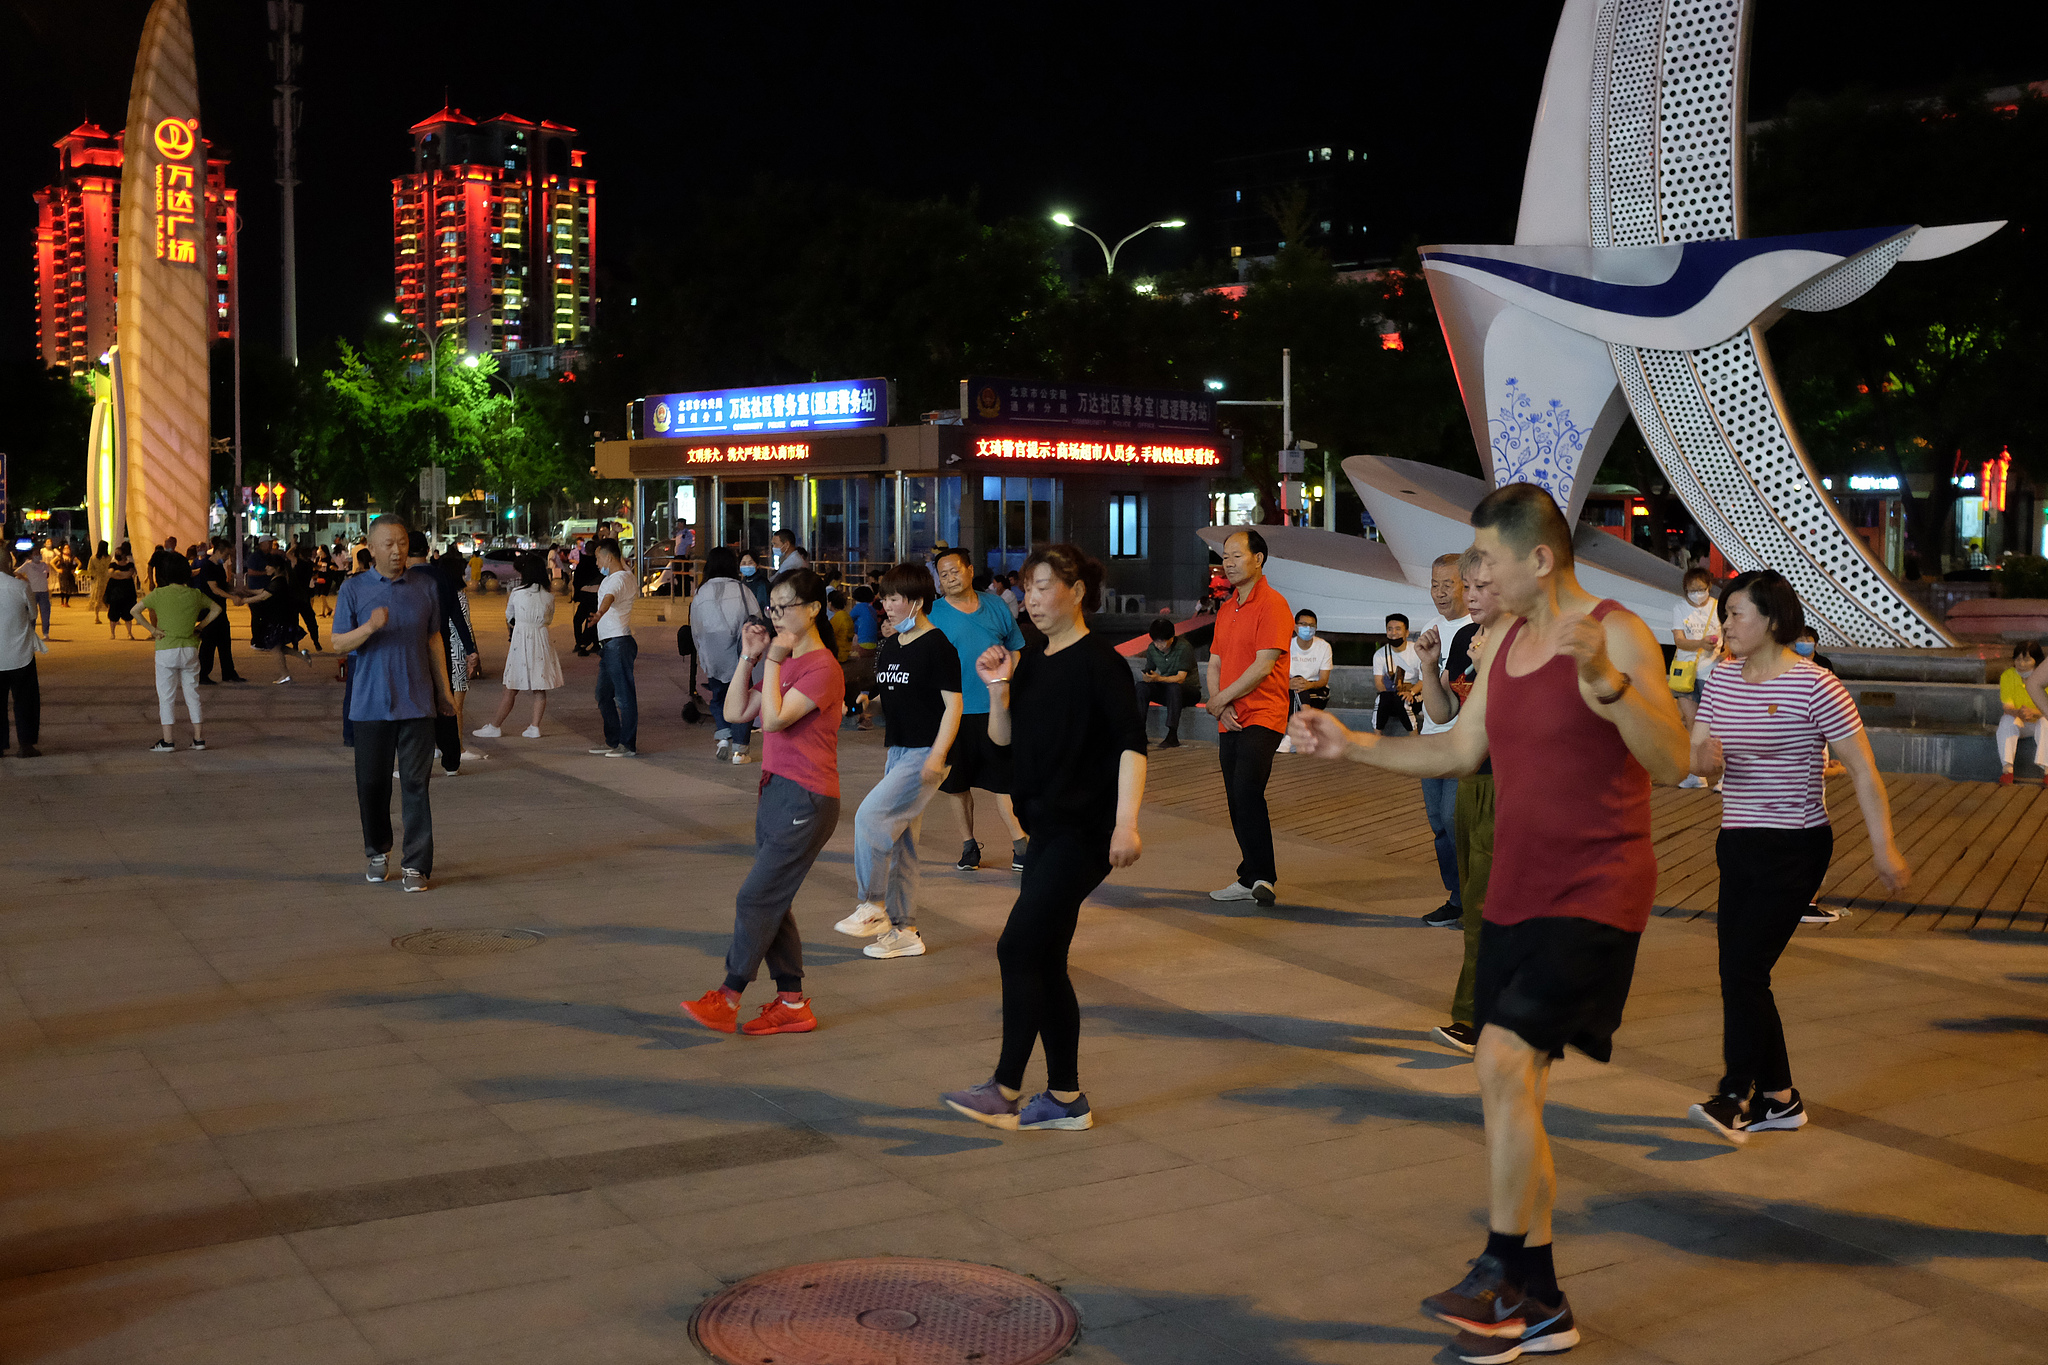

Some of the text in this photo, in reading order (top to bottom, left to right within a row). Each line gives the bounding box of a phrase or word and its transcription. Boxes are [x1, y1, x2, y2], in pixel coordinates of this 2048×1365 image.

[155, 163, 165, 259] WANDA PLAZA
[166, 163, 197, 264] 万达广场
[1010, 387, 1068, 400] 北京市公安局
[1071, 418, 1106, 426] COMMUNITY
